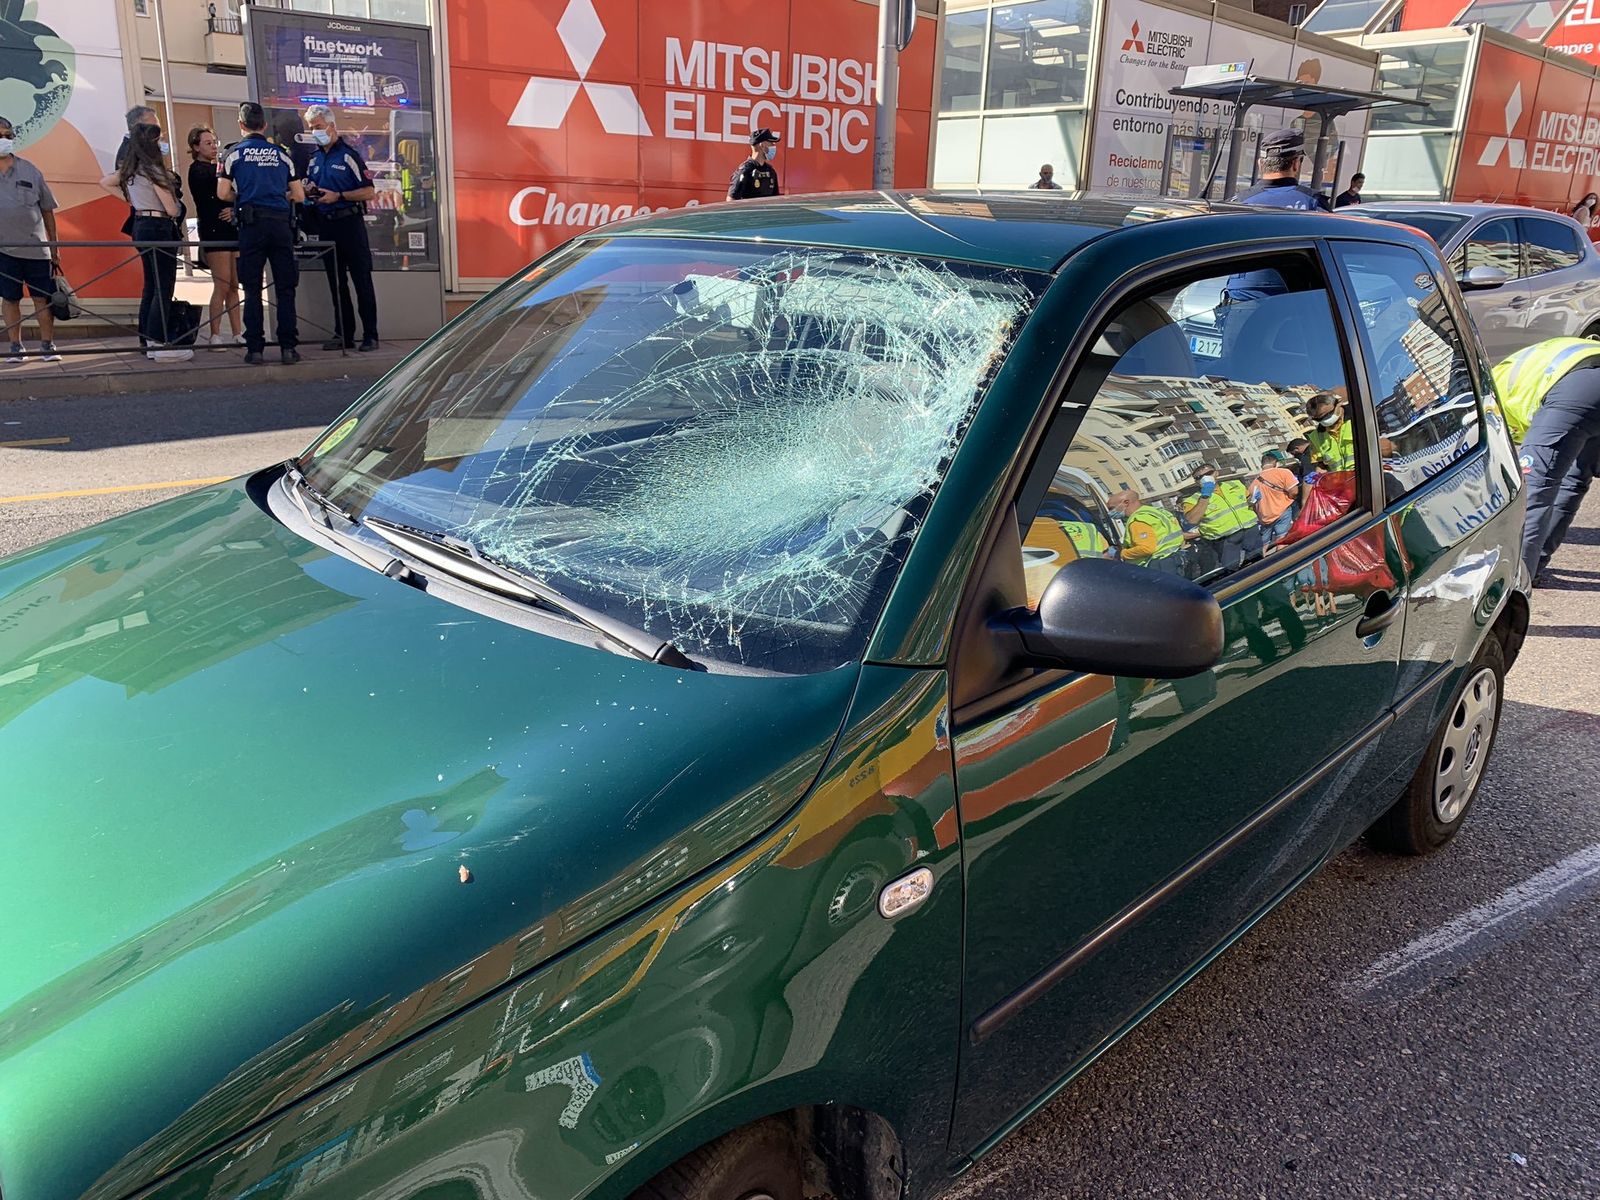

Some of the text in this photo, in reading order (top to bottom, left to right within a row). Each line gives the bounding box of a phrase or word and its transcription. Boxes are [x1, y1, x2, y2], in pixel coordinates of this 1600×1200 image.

[326, 21, 361, 32] JCDecaux
[303, 35, 383, 57] finetwork
[1148, 30, 1193, 48] MITSUBISHI
[1147, 43, 1186, 59] ELECTRIC
[1120, 54, 1147, 67] Changes
[1148, 59, 1157, 67] for
[1159, 60, 1169, 69] the
[285, 63, 326, 86] MÓVIL
[665, 37, 899, 108] MITSUBISH
[1116, 88, 1209, 114] Contribuyendo
[1212, 104, 1220, 114] a
[665, 91, 869, 154] ELECTRIC
[1112, 117, 1163, 134] entorno
[243, 147, 277, 156] POLICÍA
[244, 154, 279, 163] MUNICIPAL
[1107, 174, 1161, 190] de nuestros
